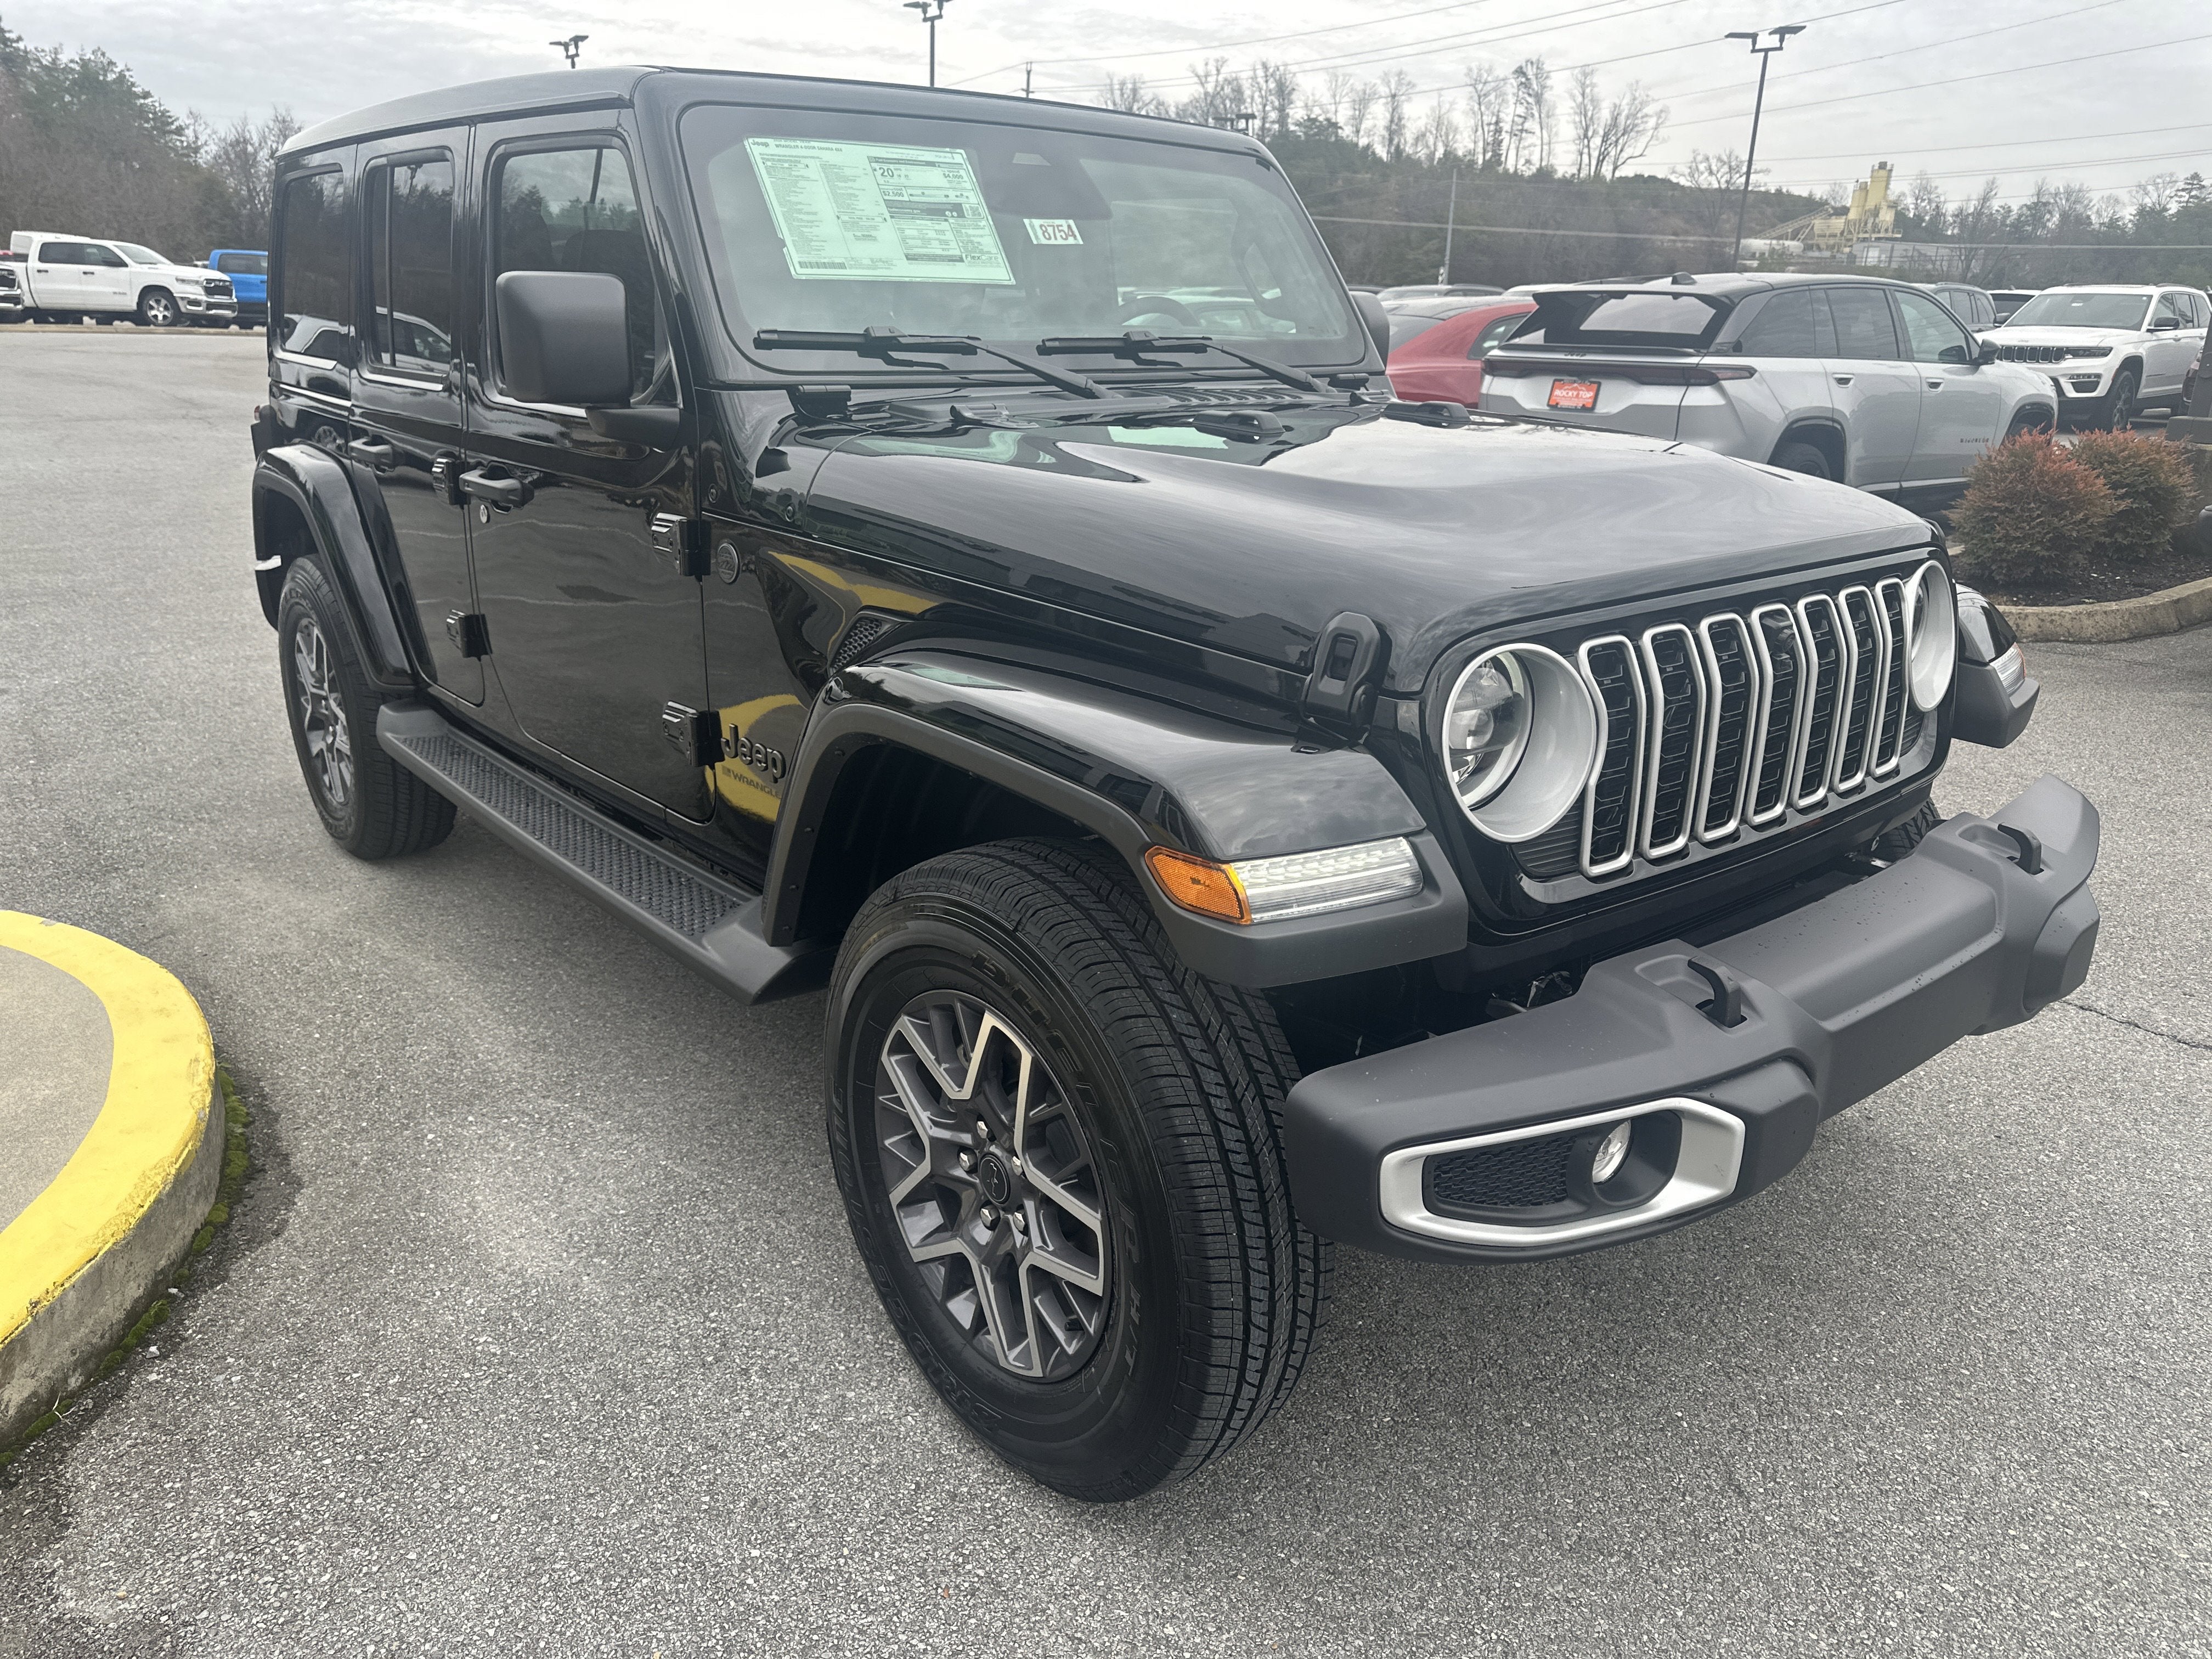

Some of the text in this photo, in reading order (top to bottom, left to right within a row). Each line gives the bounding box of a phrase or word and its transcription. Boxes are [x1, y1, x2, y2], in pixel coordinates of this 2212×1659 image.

[751, 139, 770, 148] Jeep
[878, 167, 894, 178] 20
[1039, 224, 1077, 241] 8754
[720, 723, 787, 784] Jeep
[731, 769, 782, 799] WRANGLE
